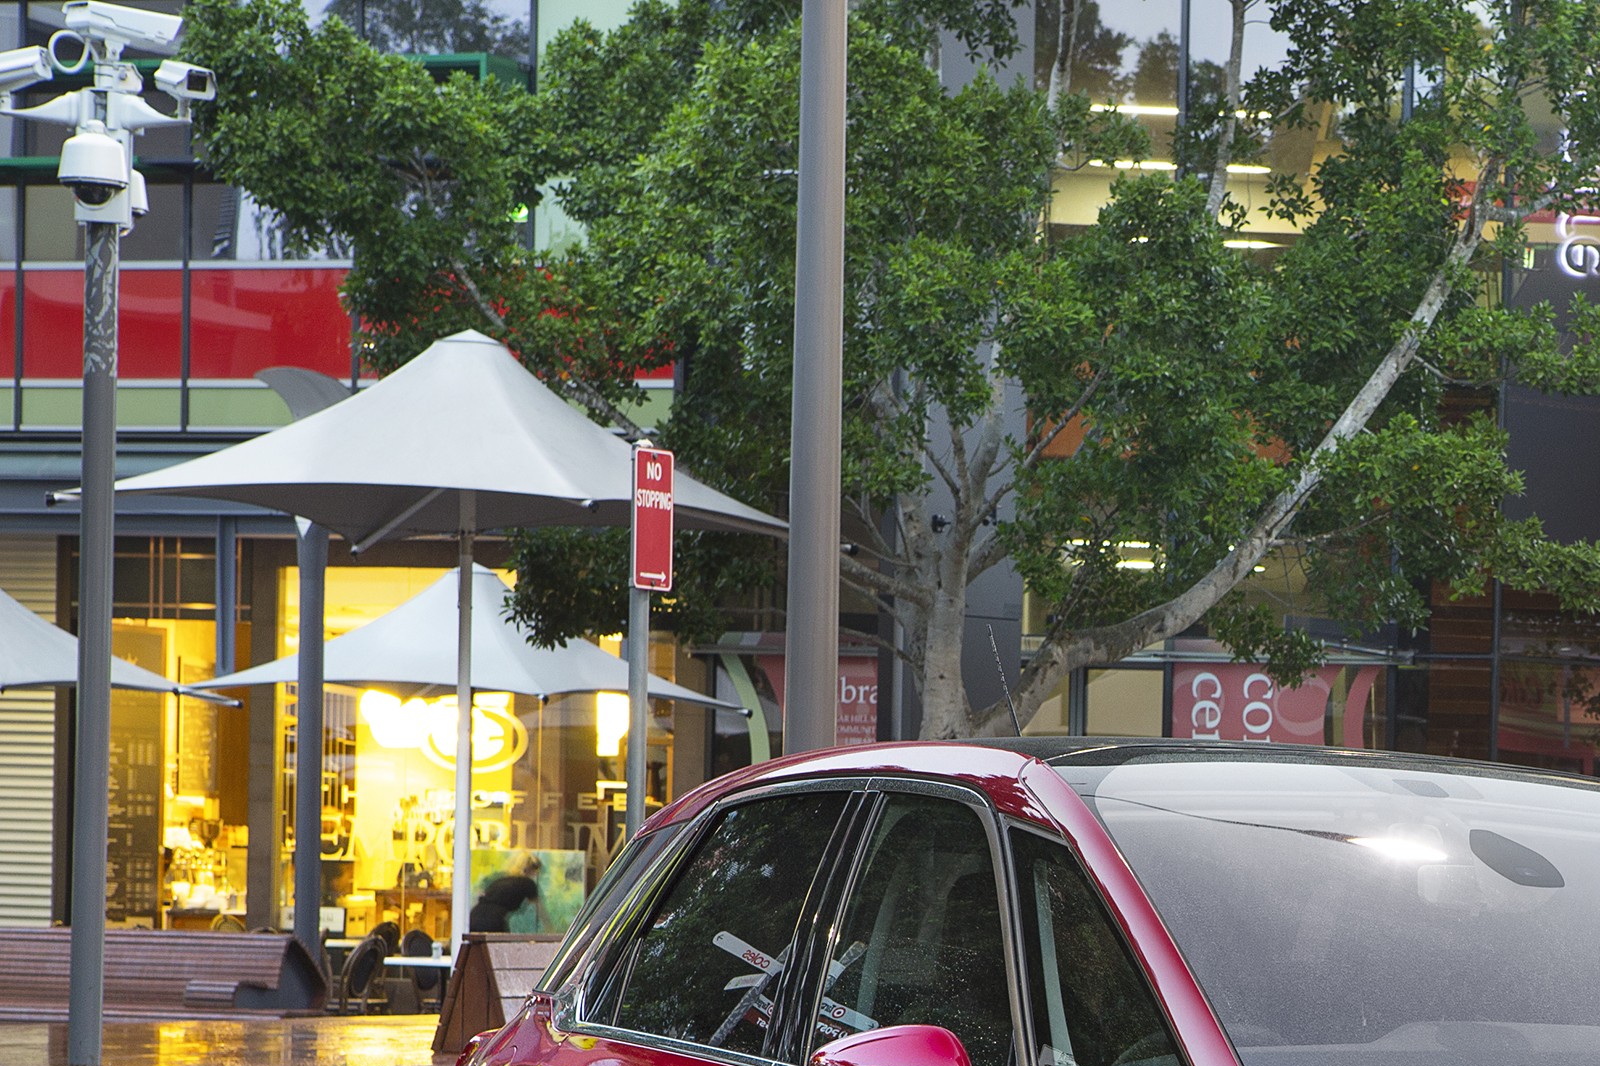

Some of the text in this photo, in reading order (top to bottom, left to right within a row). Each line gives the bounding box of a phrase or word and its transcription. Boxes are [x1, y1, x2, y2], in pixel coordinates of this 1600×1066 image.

[646, 461, 662, 481] NO
[637, 488, 671, 511] STOPPING
[471, 789, 627, 812] OFFEE
